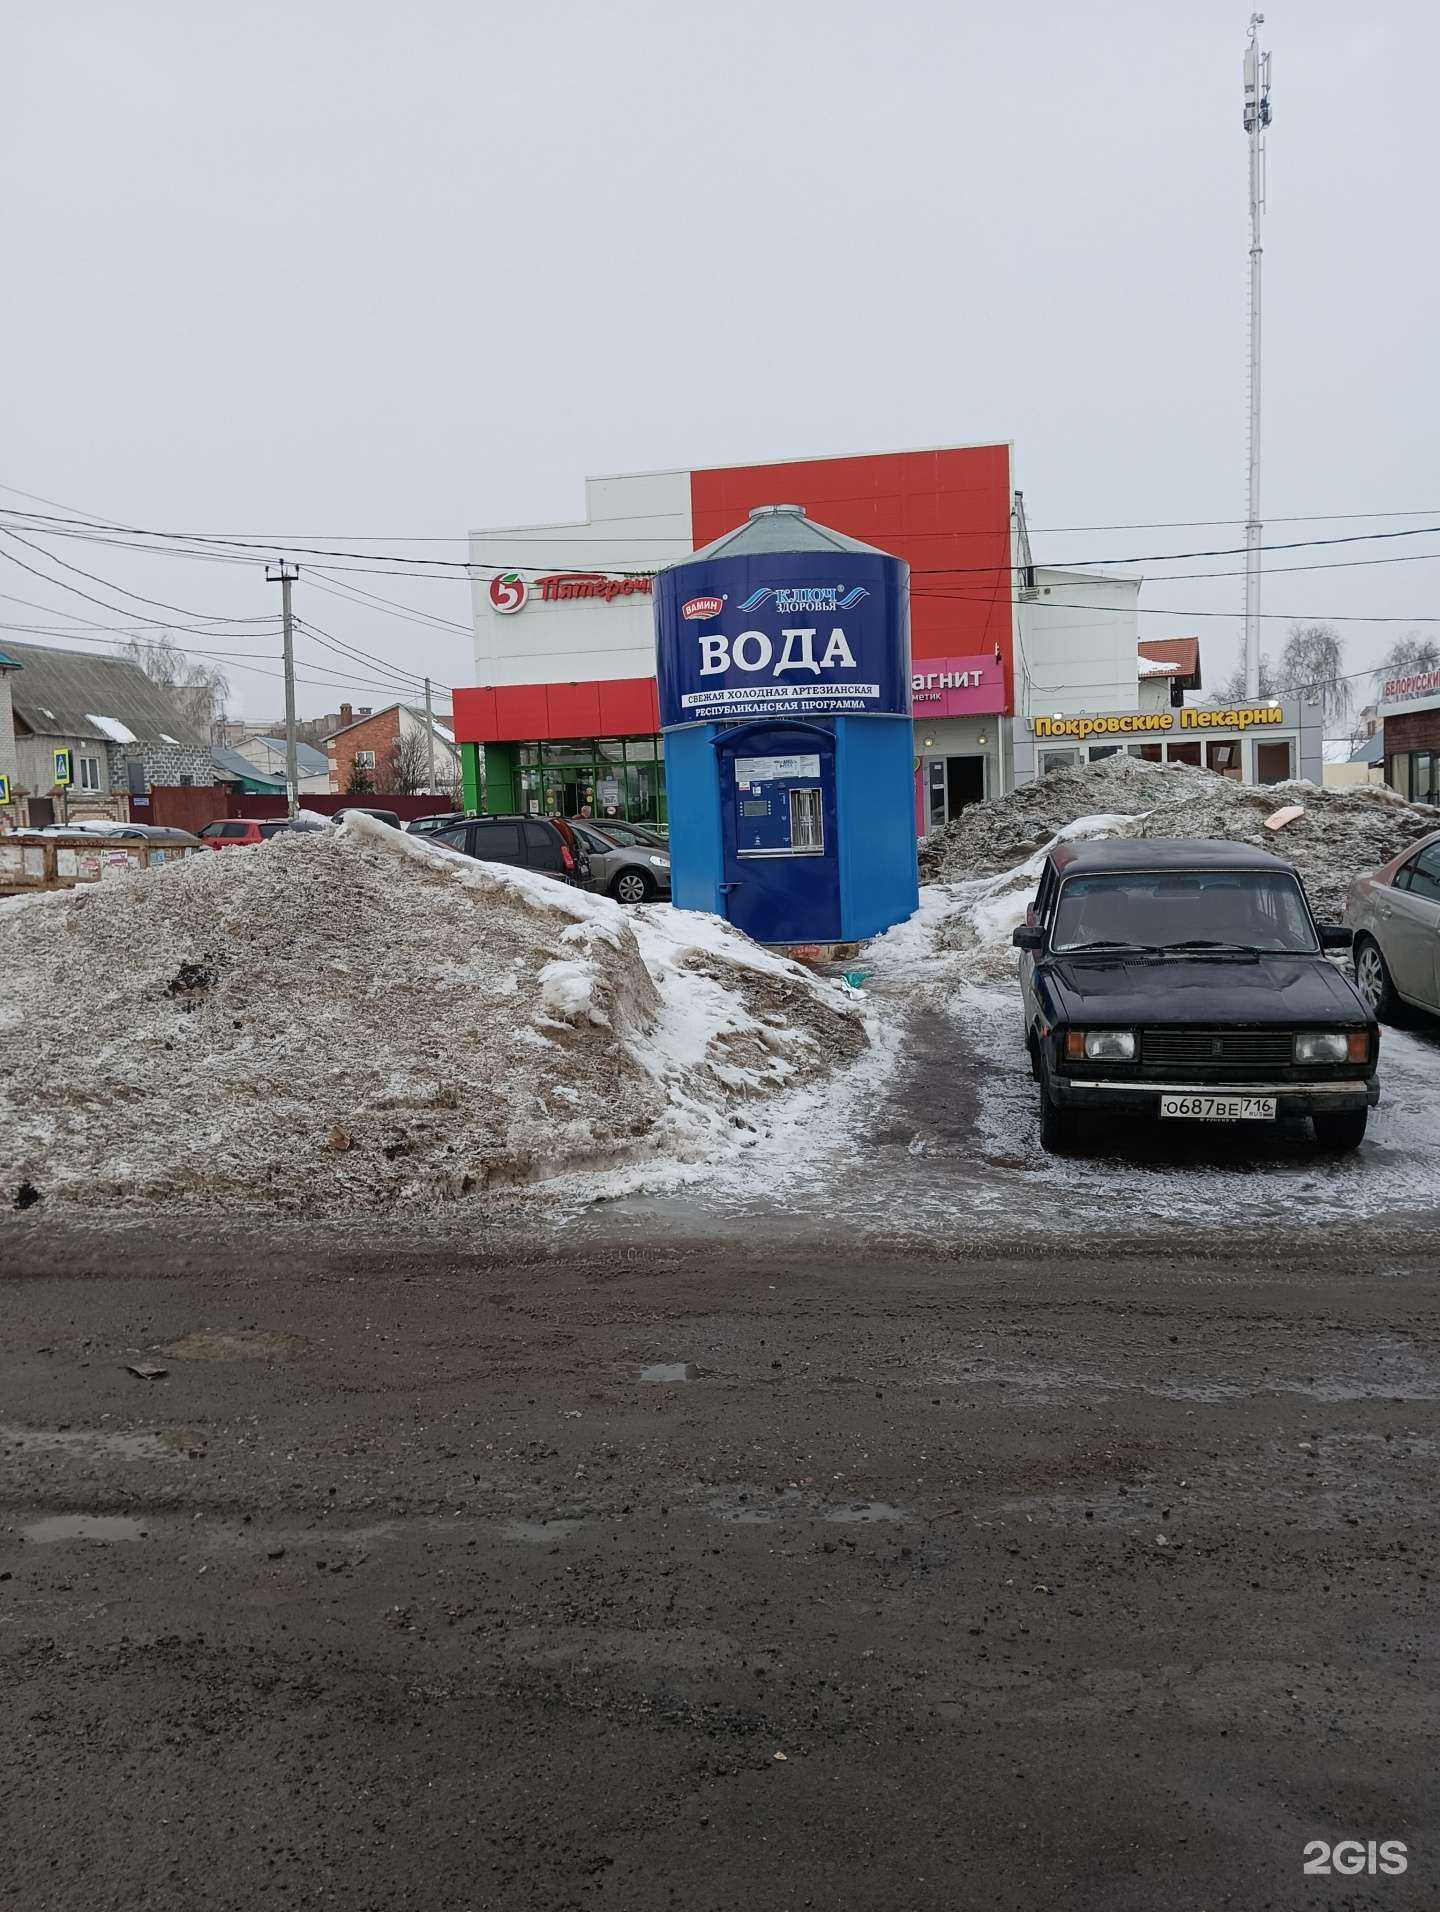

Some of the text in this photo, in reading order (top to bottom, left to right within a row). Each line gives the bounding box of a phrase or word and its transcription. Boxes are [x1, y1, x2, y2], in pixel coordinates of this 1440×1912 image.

[534, 573, 653, 602] Пятероч
[774, 588, 838, 603] КЛЮЧ
[684, 601, 718, 615] ВАМИН
[776, 602, 837, 614] ЗДОРОВЬЯ
[698, 628, 857, 677] ВОДА
[687, 685, 873, 704] СВЕЖАЯ ХОЛОДНАЯ АРТЕЗИАНСКАЯ
[695, 699, 866, 717] РЕСПУБЛИКАНСКАЯ ПРОГРАММА
[1034, 707, 1283, 739] Покровские Пекарни
